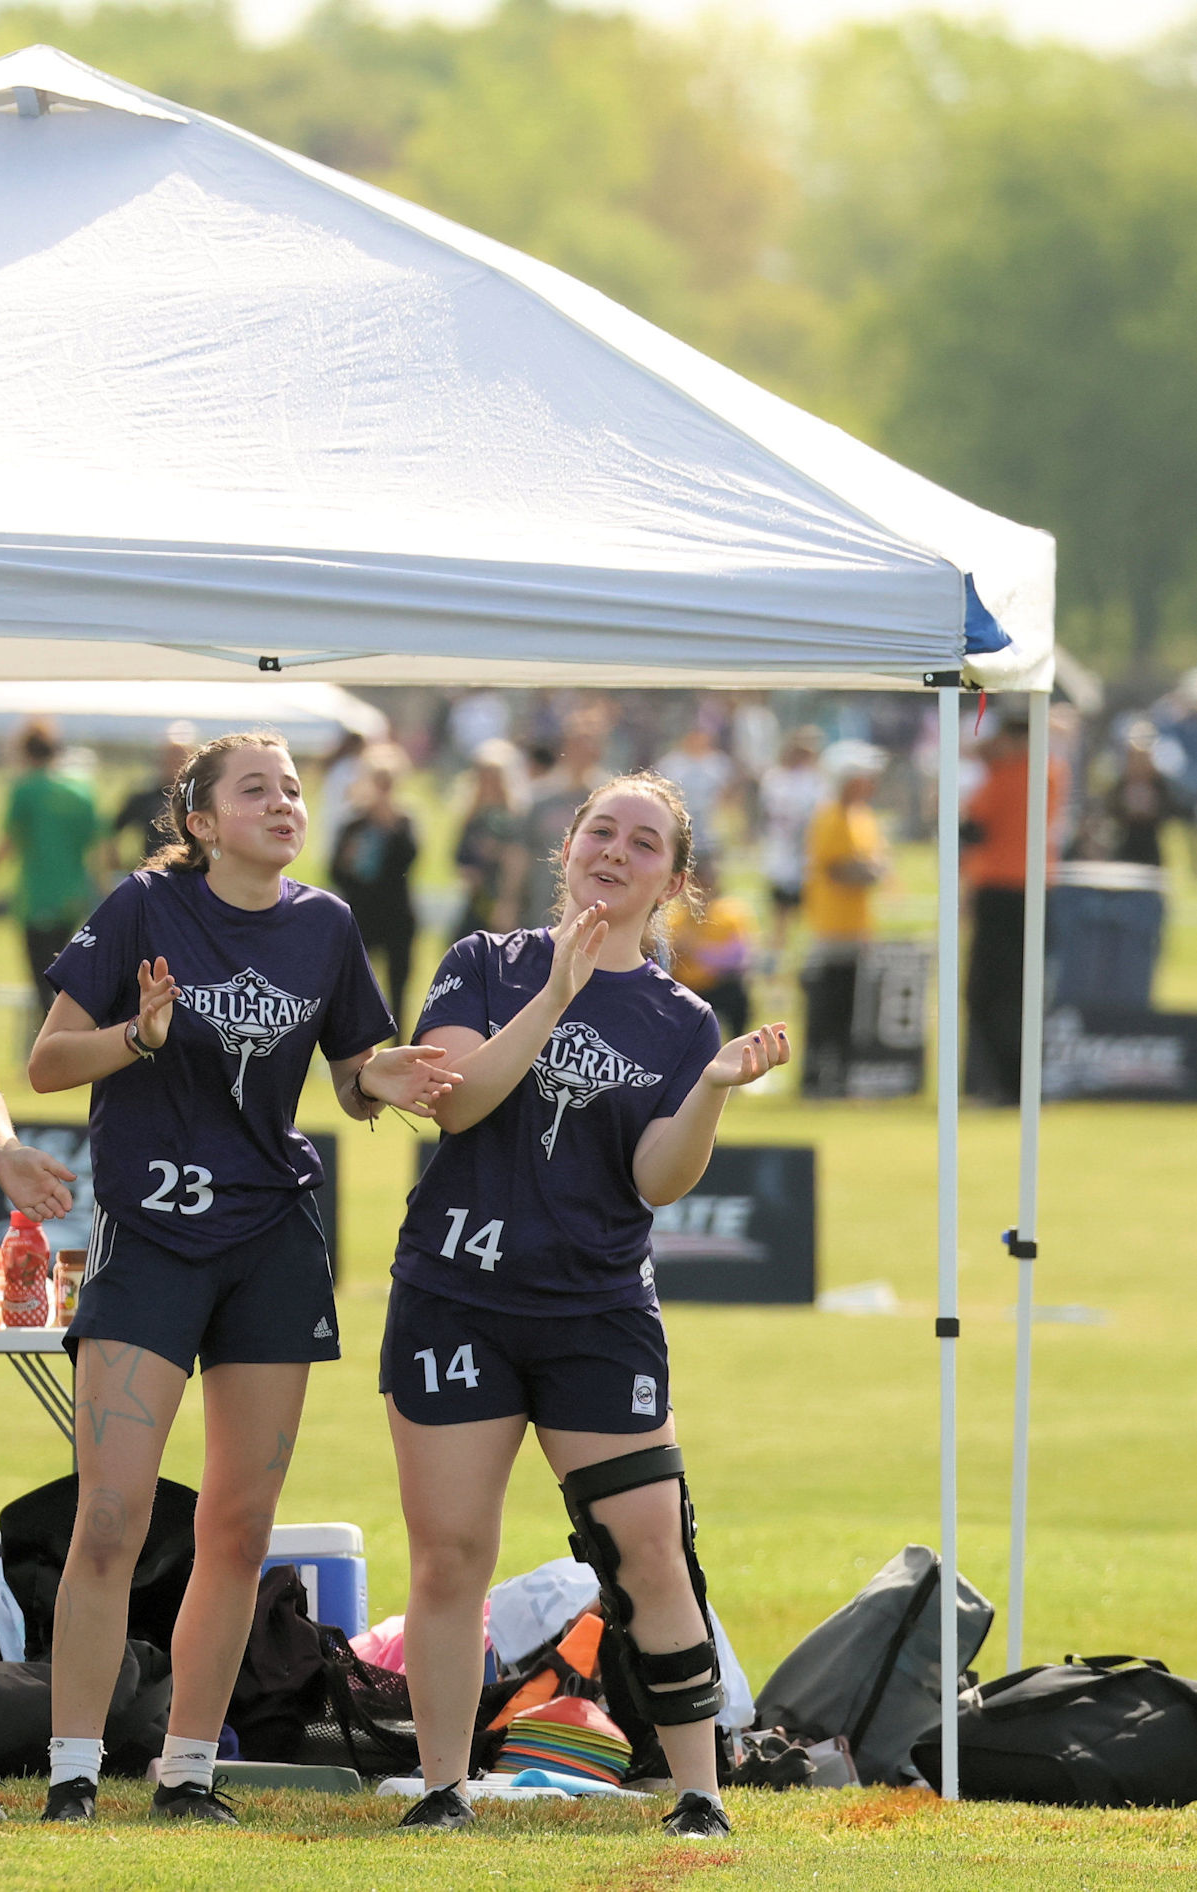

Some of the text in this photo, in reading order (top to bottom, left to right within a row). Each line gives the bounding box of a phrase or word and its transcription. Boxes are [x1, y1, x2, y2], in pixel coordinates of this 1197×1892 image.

[194, 989, 304, 1027] BLU-RAY
[141, 1160, 215, 1216] 23
[439, 1207, 505, 1273] 14
[414, 1343, 482, 1393] 14
